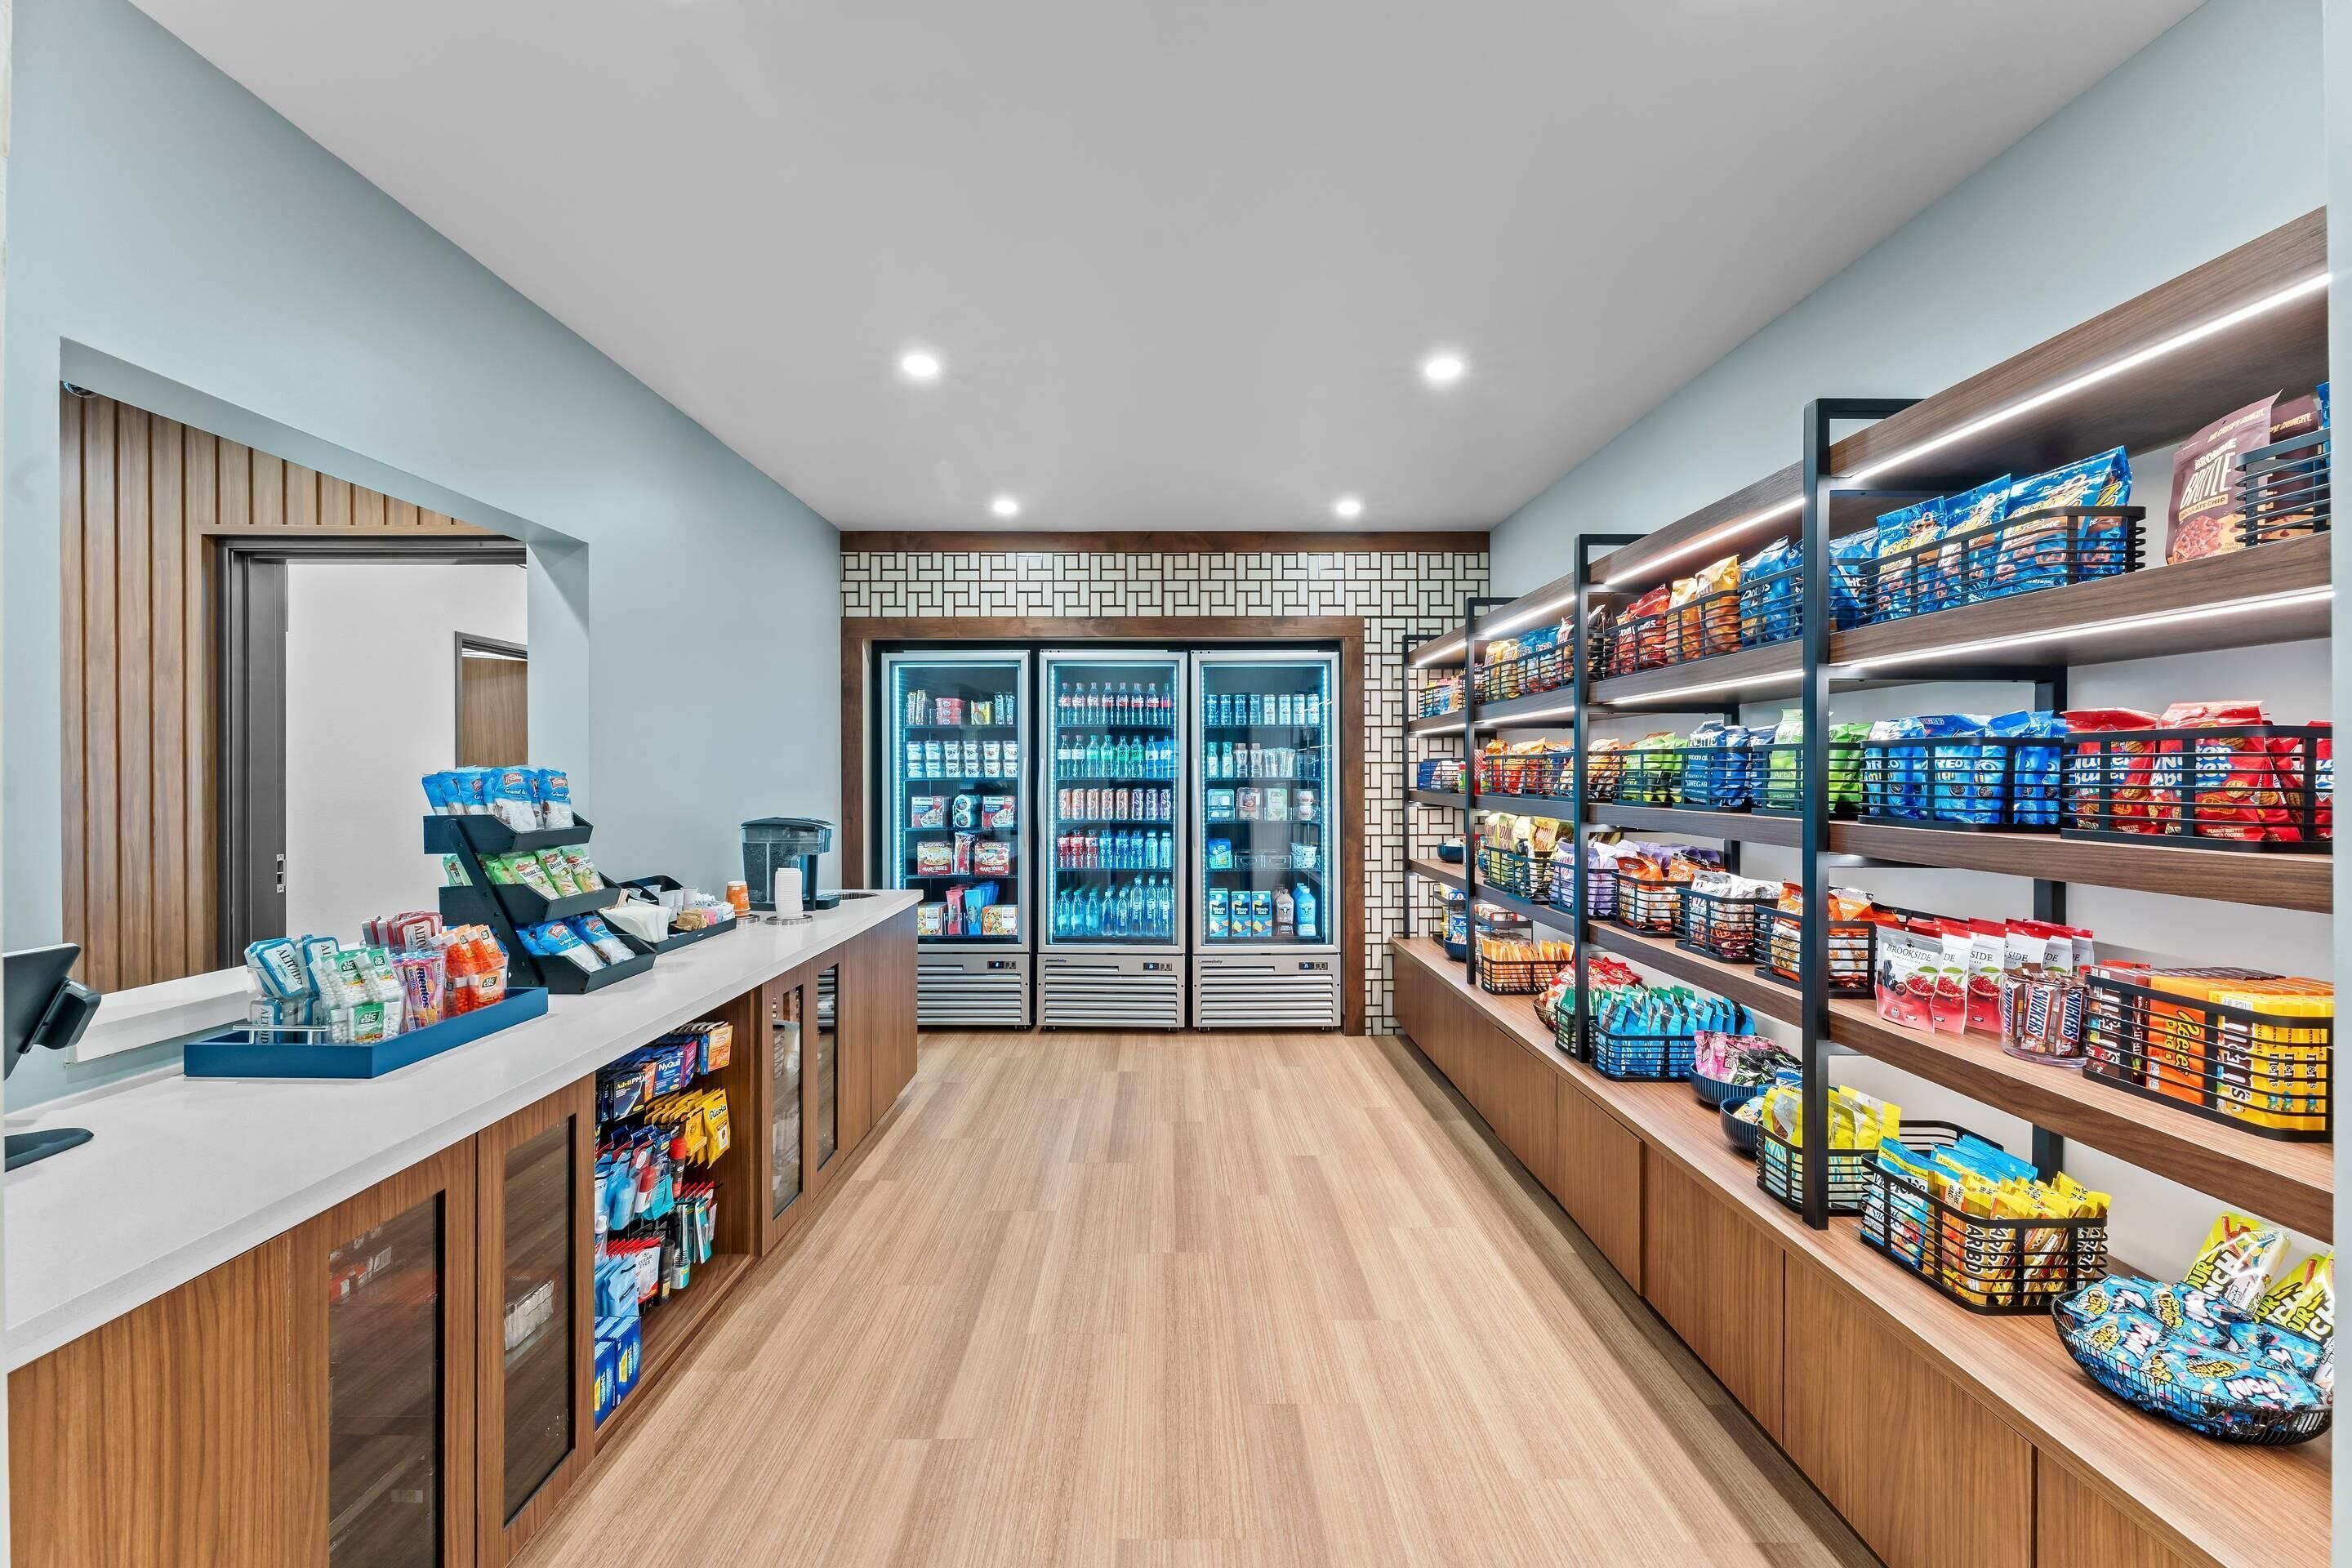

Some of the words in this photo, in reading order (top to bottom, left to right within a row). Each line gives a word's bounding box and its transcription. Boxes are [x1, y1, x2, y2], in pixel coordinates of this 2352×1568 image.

[549, 861, 562, 869] Bear
[276, 947, 303, 986] ALTOIDS
[1886, 944, 1932, 963] BROOKSIDE
[416, 967, 430, 1009] mentos
[2004, 982, 2014, 1036] SNICKERS
[2028, 985, 2049, 1040] SNICKERS
[2063, 988, 2082, 1042] SNICKERS
[616, 1079, 632, 1090] Advil
[658, 1058, 681, 1072] NyQuil
[709, 1103, 727, 1120] Ricola
[1964, 1215, 1986, 1274] ARIBO
